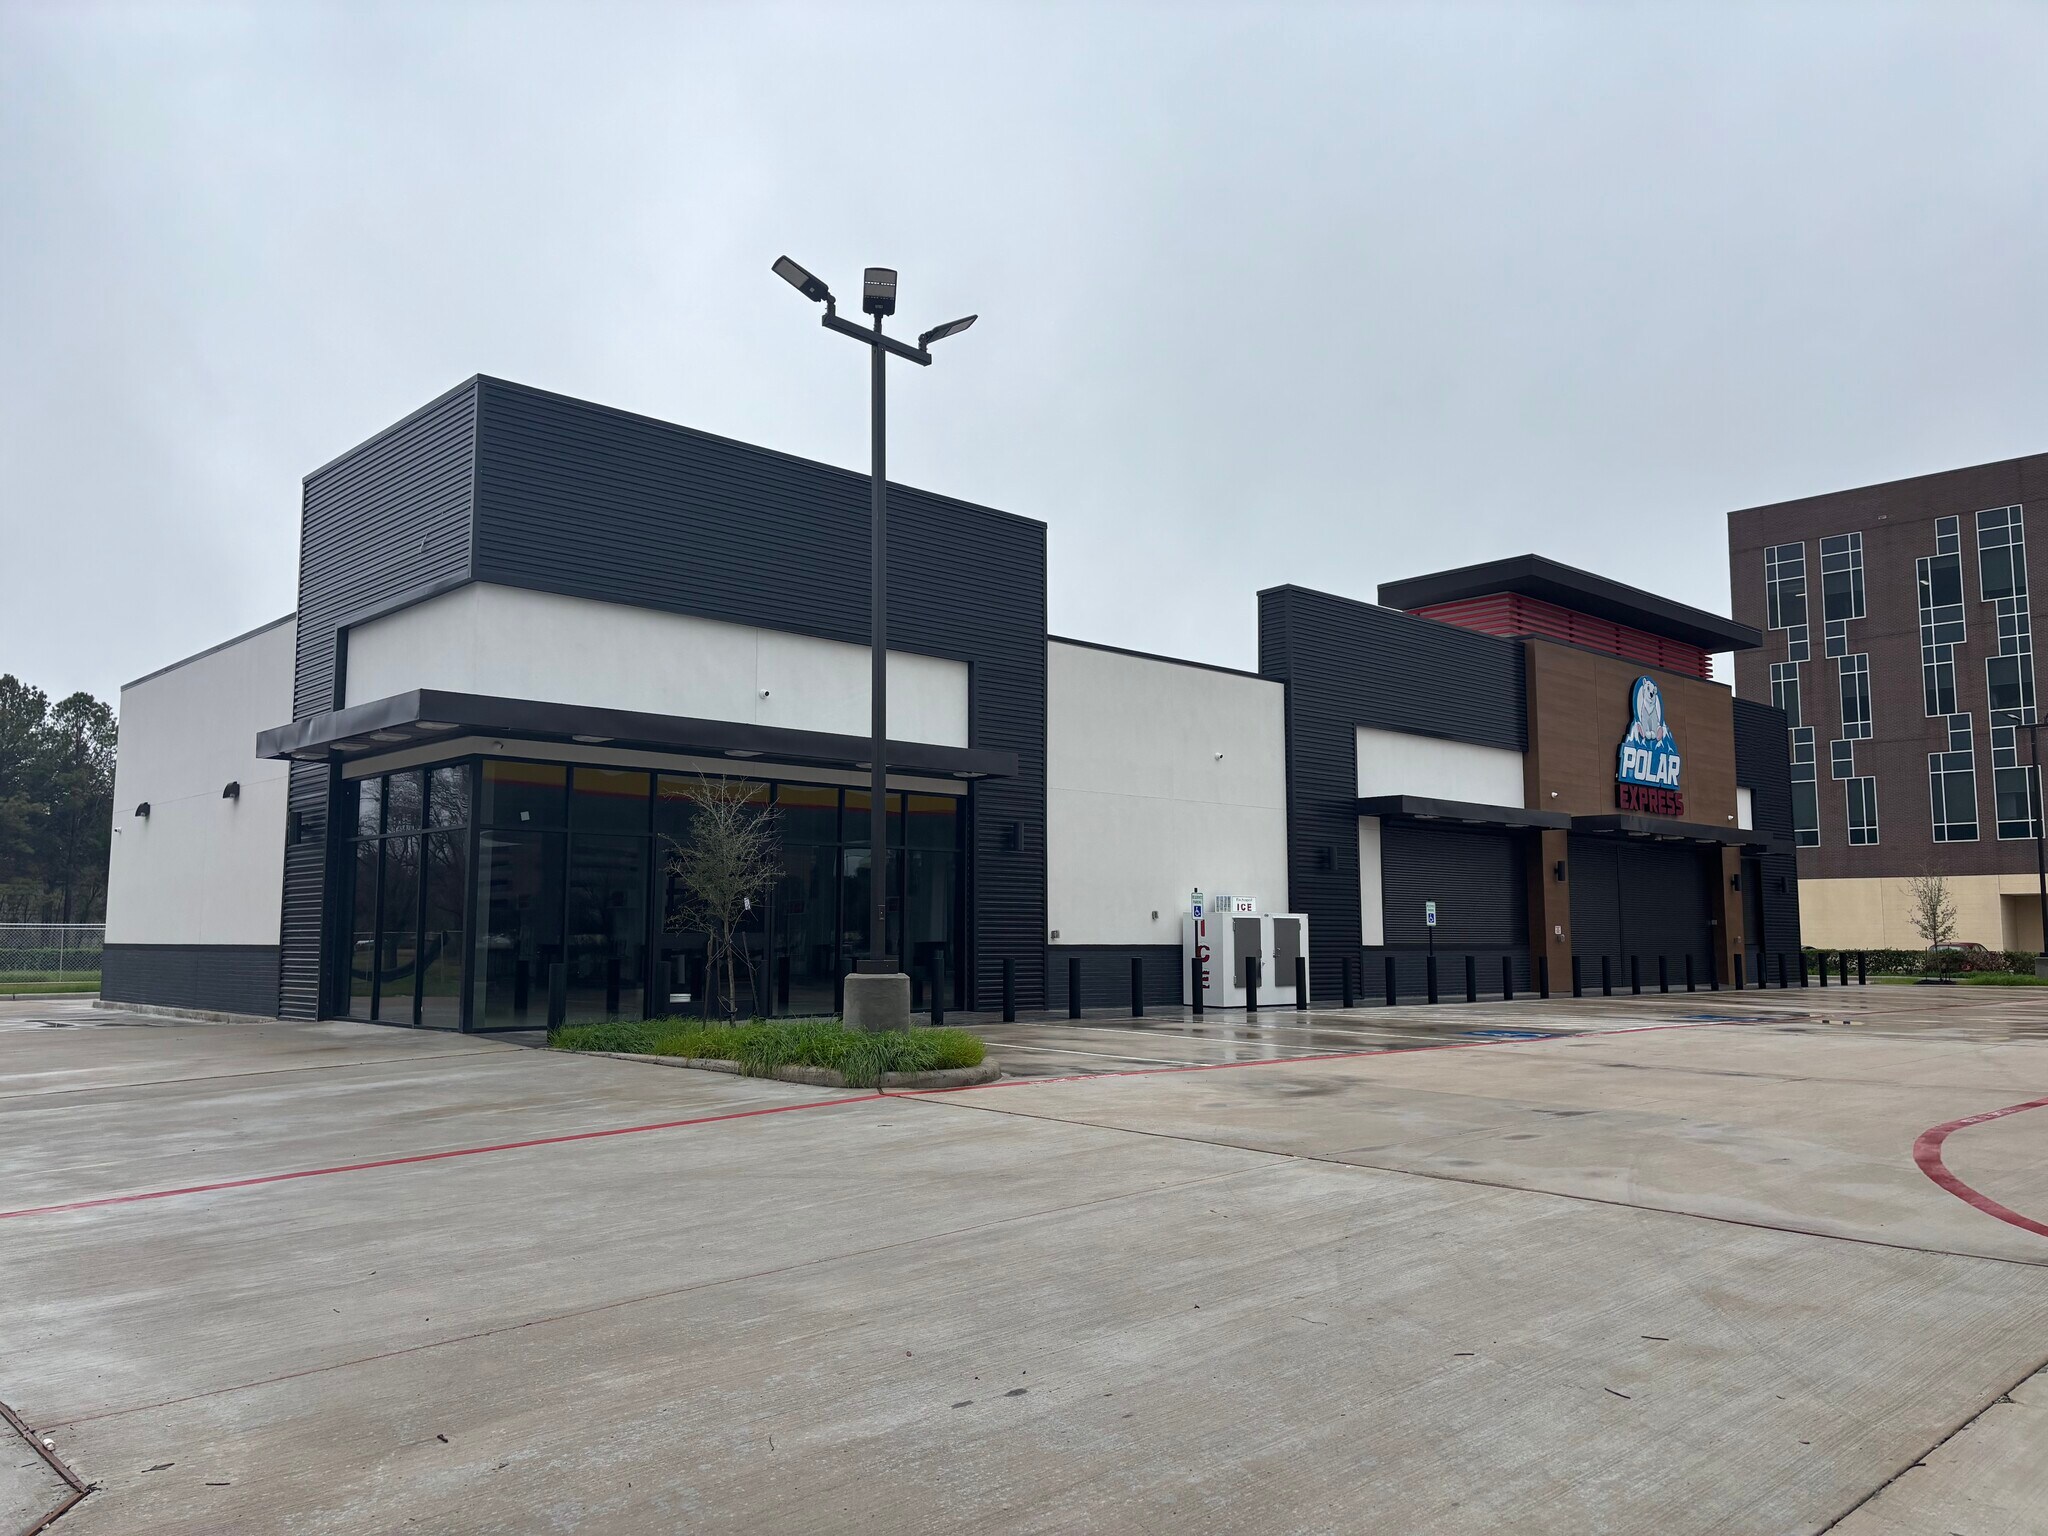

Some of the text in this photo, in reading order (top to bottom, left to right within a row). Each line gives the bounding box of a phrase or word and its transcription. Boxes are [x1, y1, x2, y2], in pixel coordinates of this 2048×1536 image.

[1621, 746, 1681, 786] POLAR
[1619, 784, 1684, 816] EXPRESS
[1236, 903, 1252, 912] ICE
